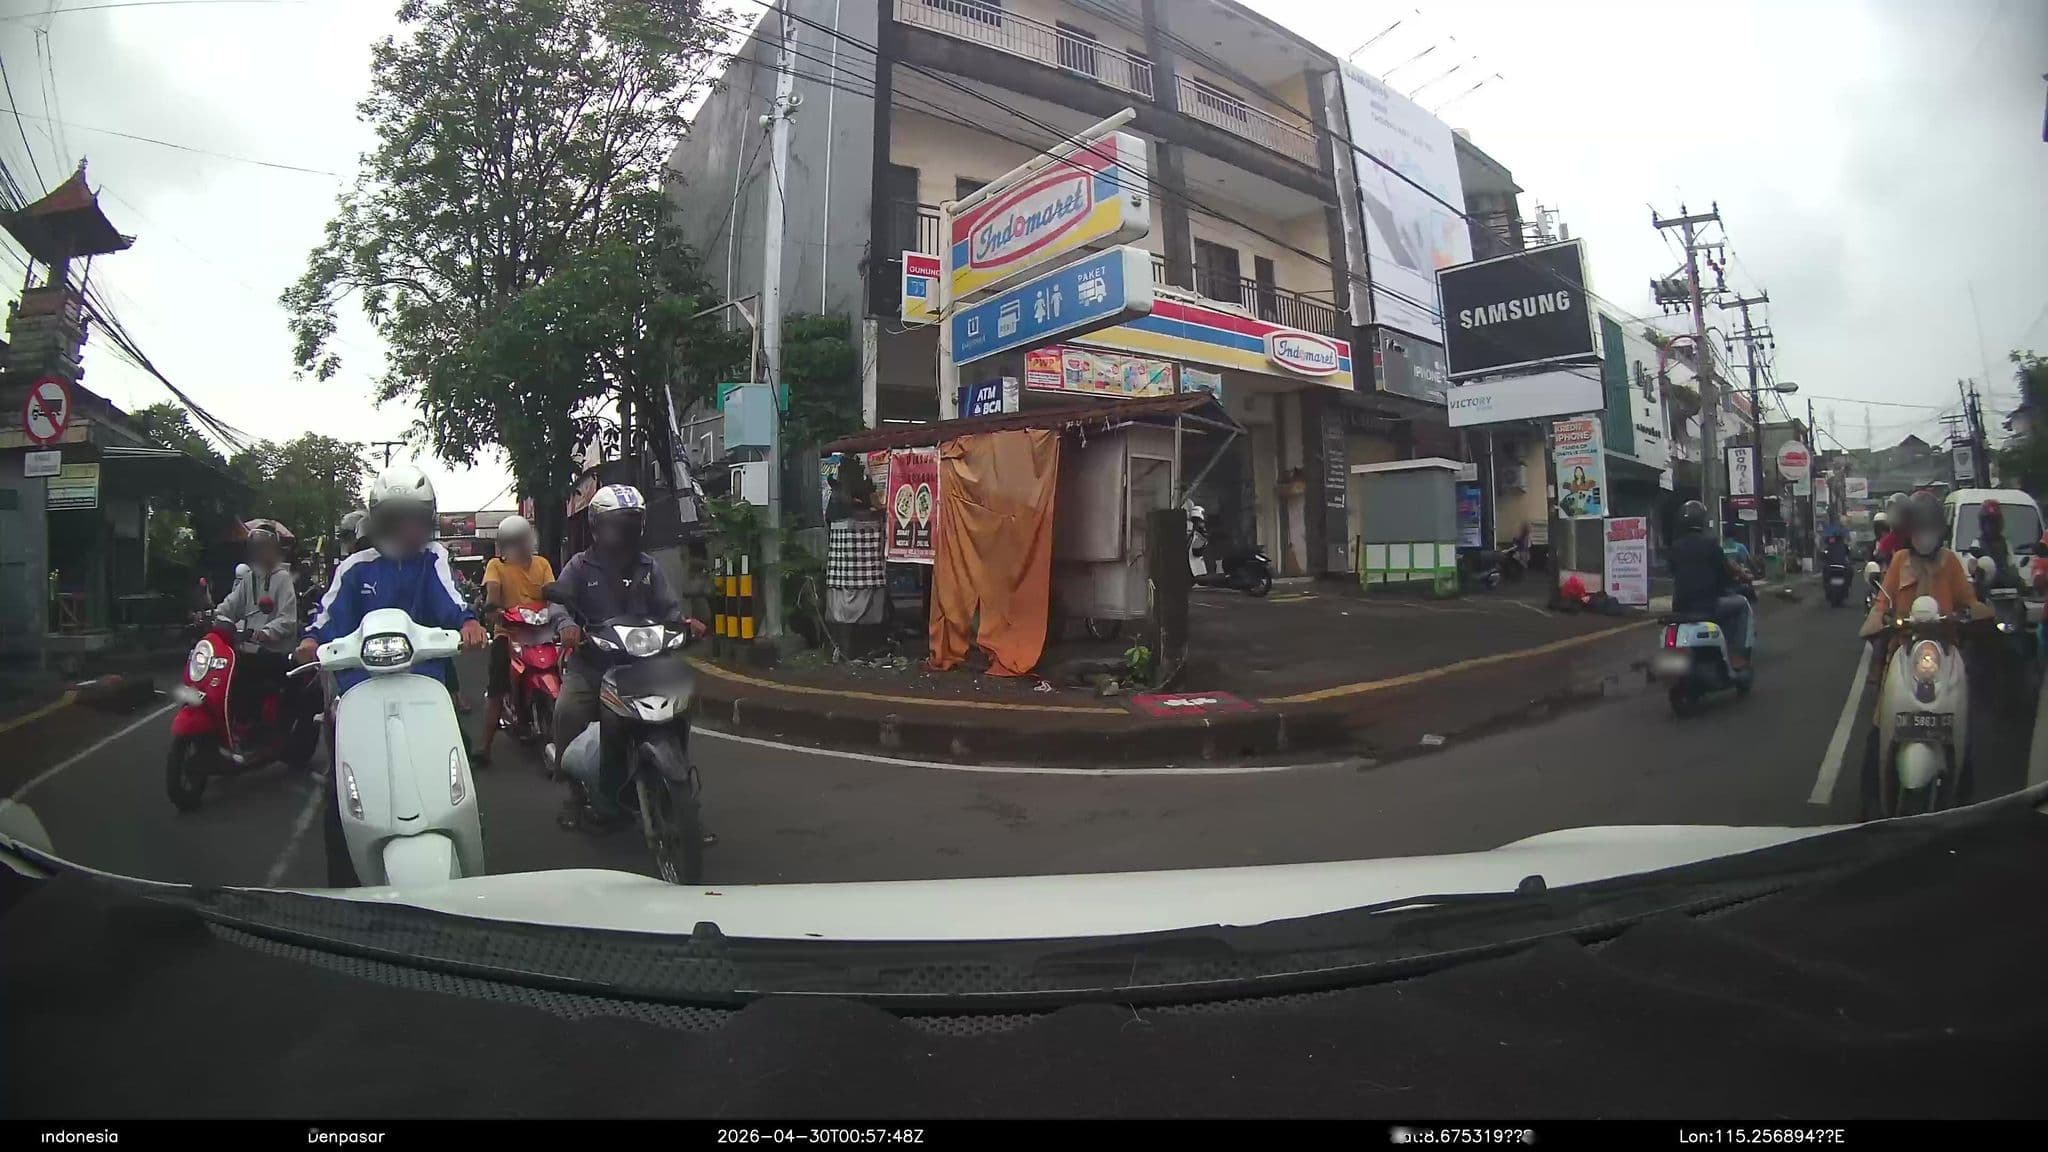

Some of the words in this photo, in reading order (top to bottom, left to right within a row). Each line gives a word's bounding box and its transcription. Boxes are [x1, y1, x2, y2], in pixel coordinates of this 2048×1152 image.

[977, 180, 1084, 260] Indomaret
[1077, 265, 1106, 283] PAKET
[1459, 290, 1571, 329] SAMSUNG
[1278, 340, 1334, 365] Indomaret
[976, 385, 996, 402] ATM
[983, 400, 1001, 415] BCA
[1450, 396, 1492, 409] VICTORY
[1555, 430, 1592, 442] IPHONE
